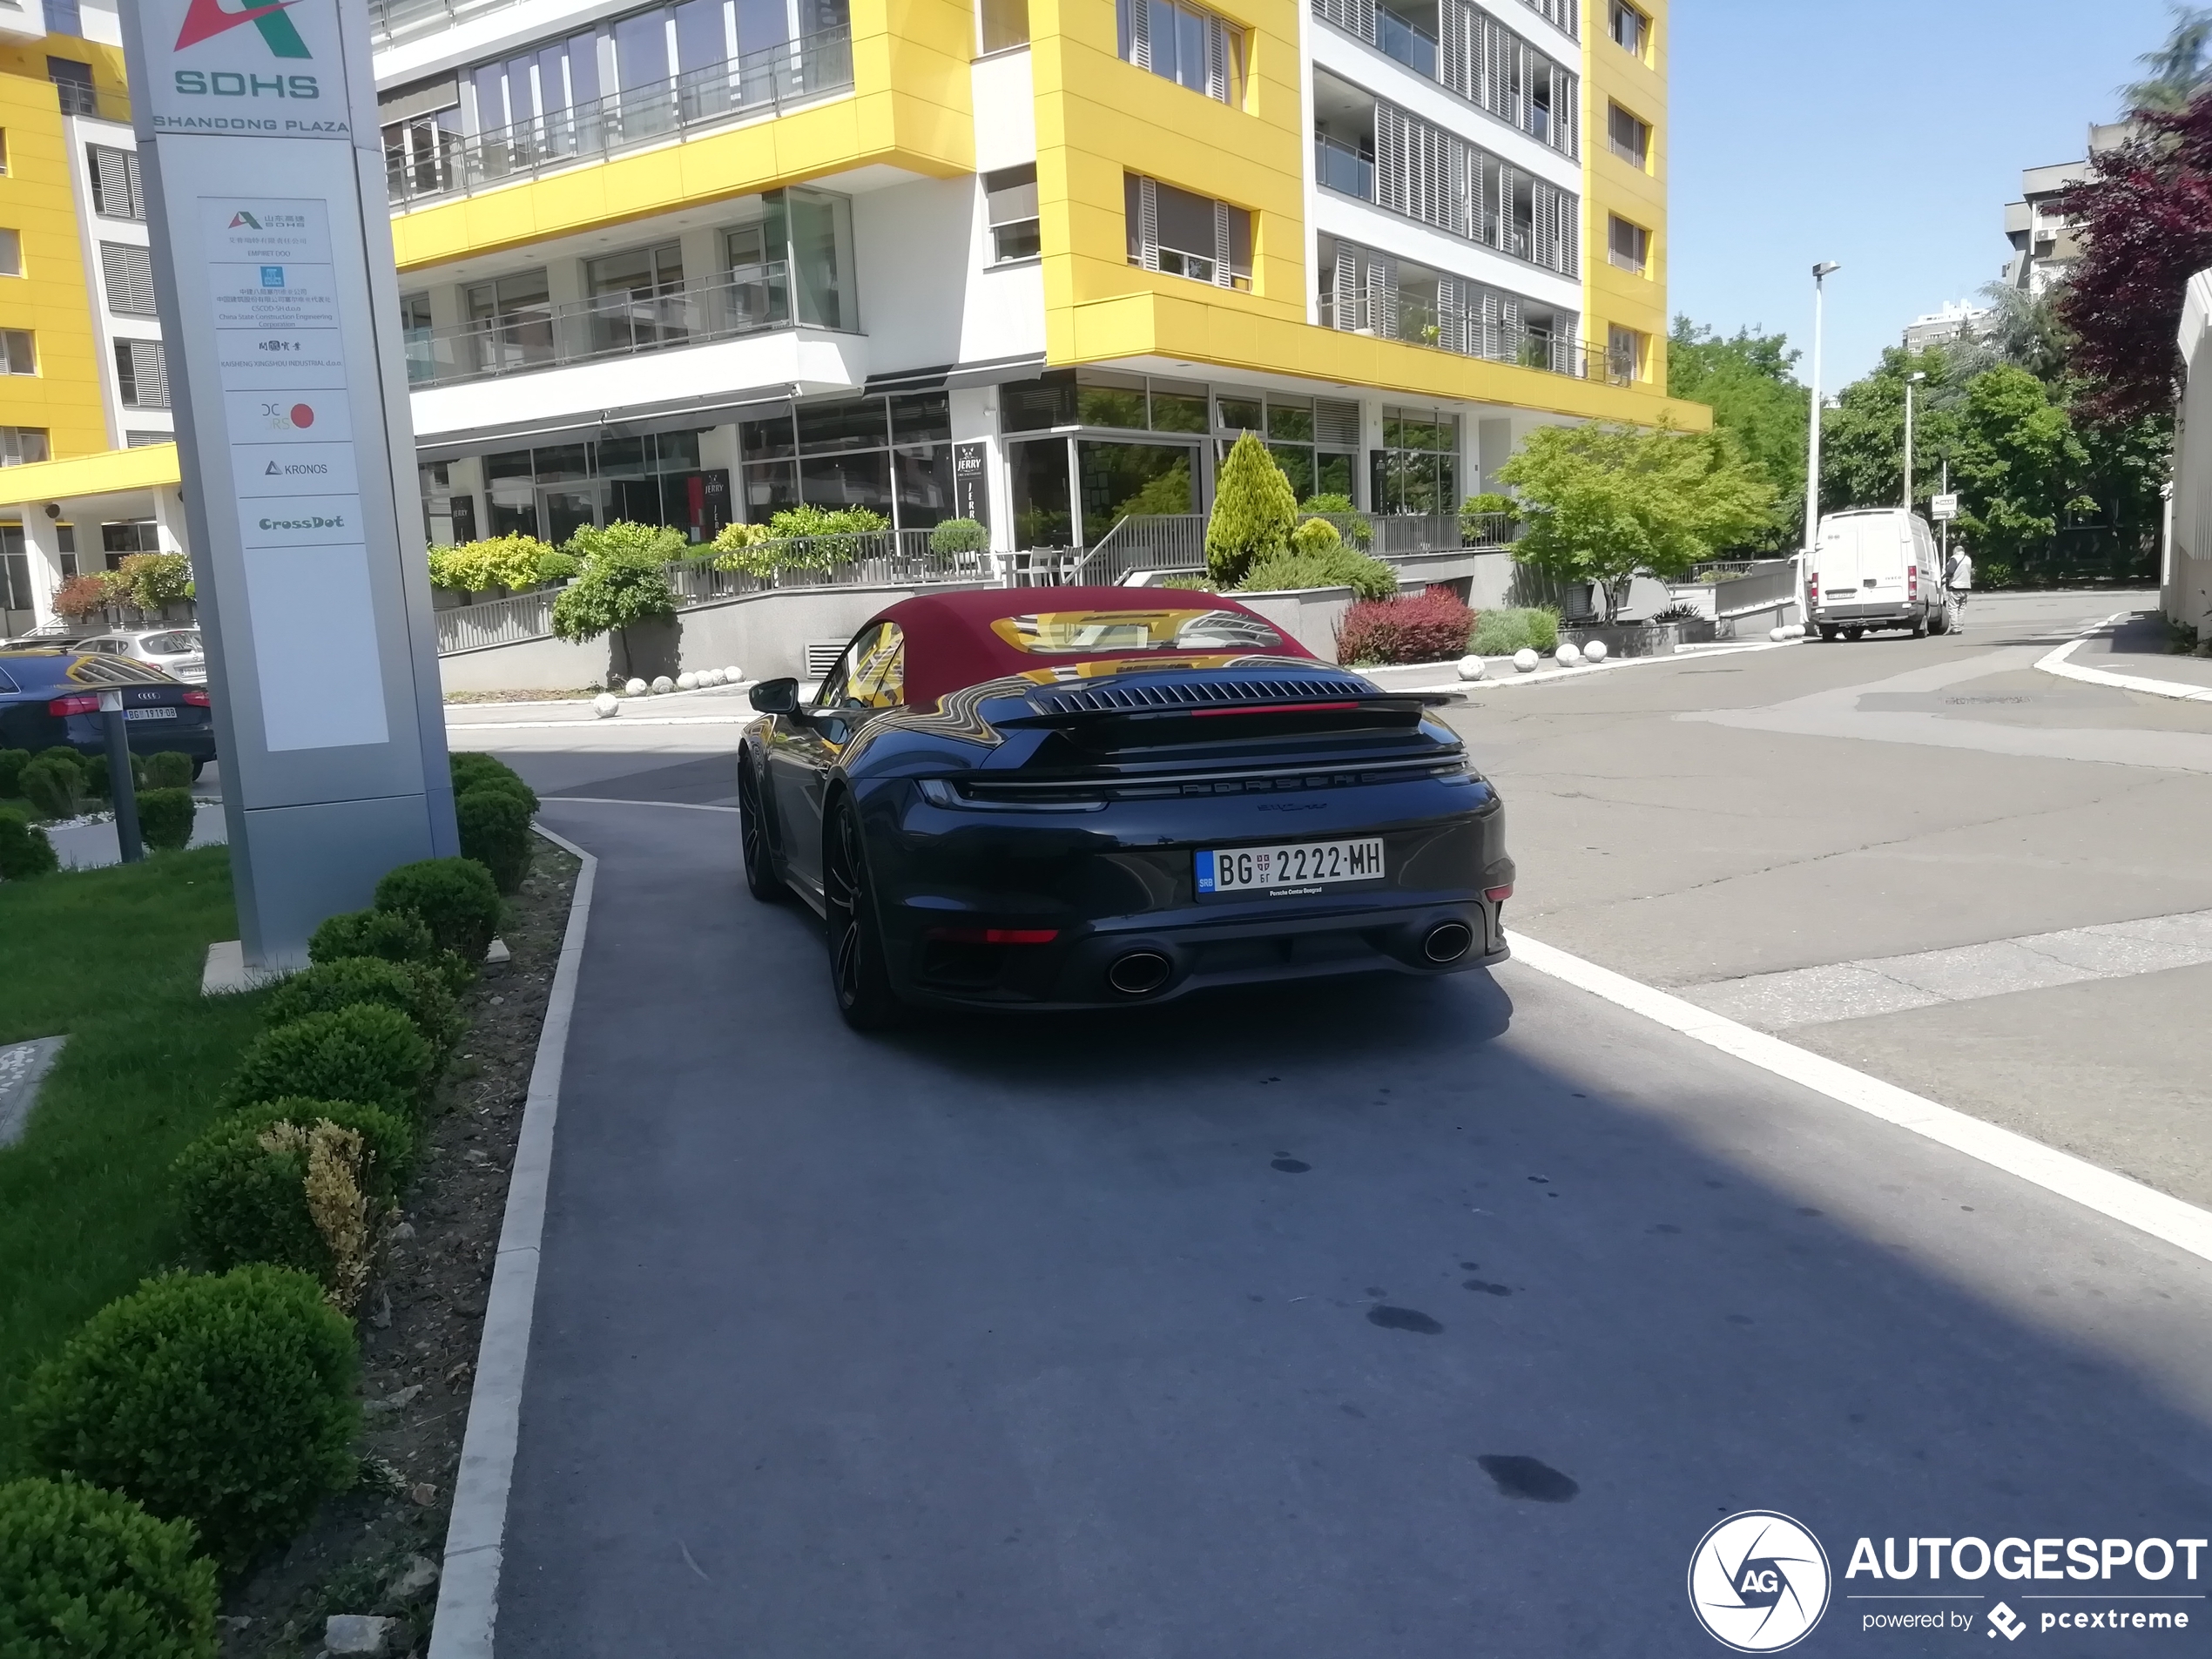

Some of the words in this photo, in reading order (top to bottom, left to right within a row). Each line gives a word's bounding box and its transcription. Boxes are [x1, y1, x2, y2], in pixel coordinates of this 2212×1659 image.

[175, 71, 320, 99] SDHS
[152, 116, 277, 130] SHANDONG
[286, 120, 350, 132] PLAZA
[285, 464, 327, 475] KRONOS
[957, 459, 981, 471] JERRY
[705, 484, 724, 495] JERRY
[259, 516, 345, 530] CrossDot
[1183, 772, 1376, 794] PORSCHE
[1199, 879, 1213, 887] SRB
[1219, 853, 1252, 887] BG
